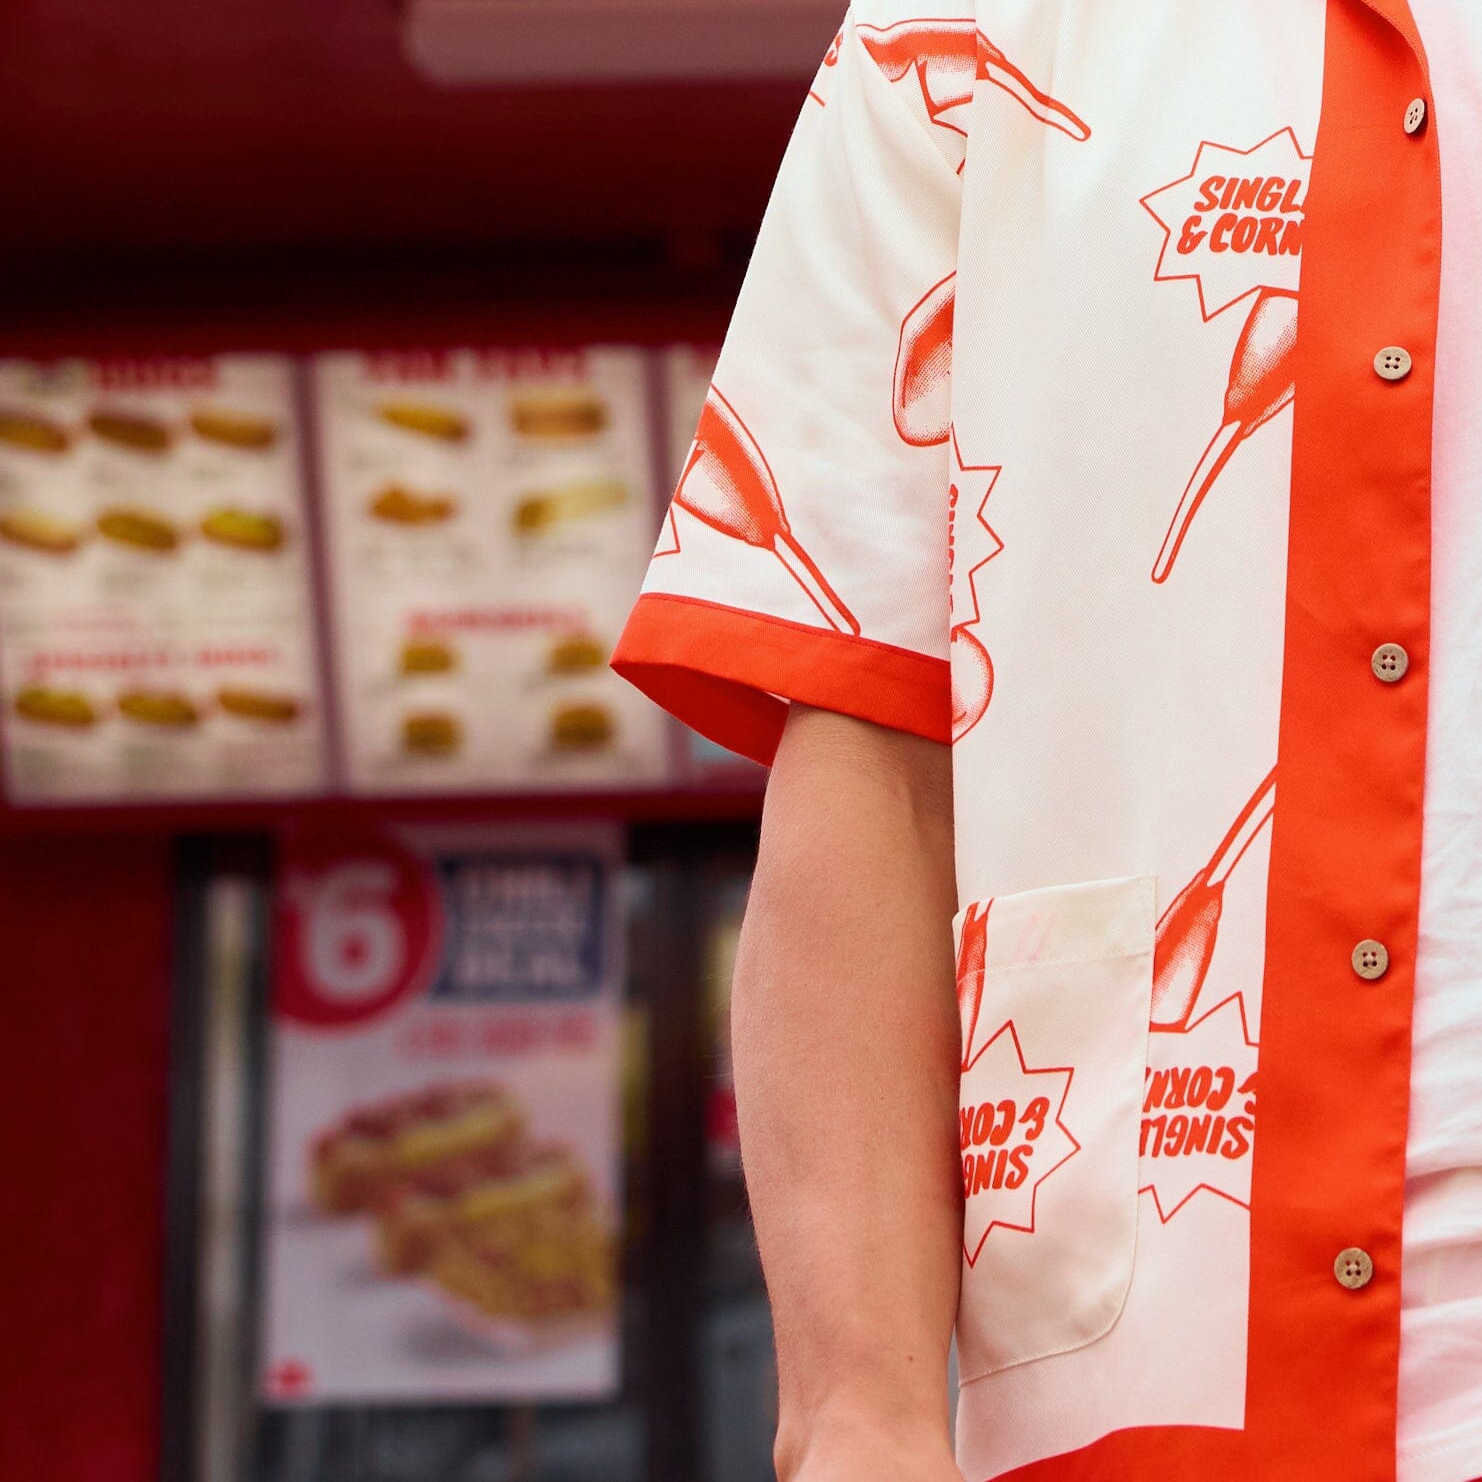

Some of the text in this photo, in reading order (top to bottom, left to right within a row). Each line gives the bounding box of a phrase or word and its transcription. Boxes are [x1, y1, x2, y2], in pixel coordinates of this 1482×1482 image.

[1177, 215, 1208, 255] &
[1143, 1066, 1236, 1113] CORN
[1018, 1097, 1050, 1141] &
